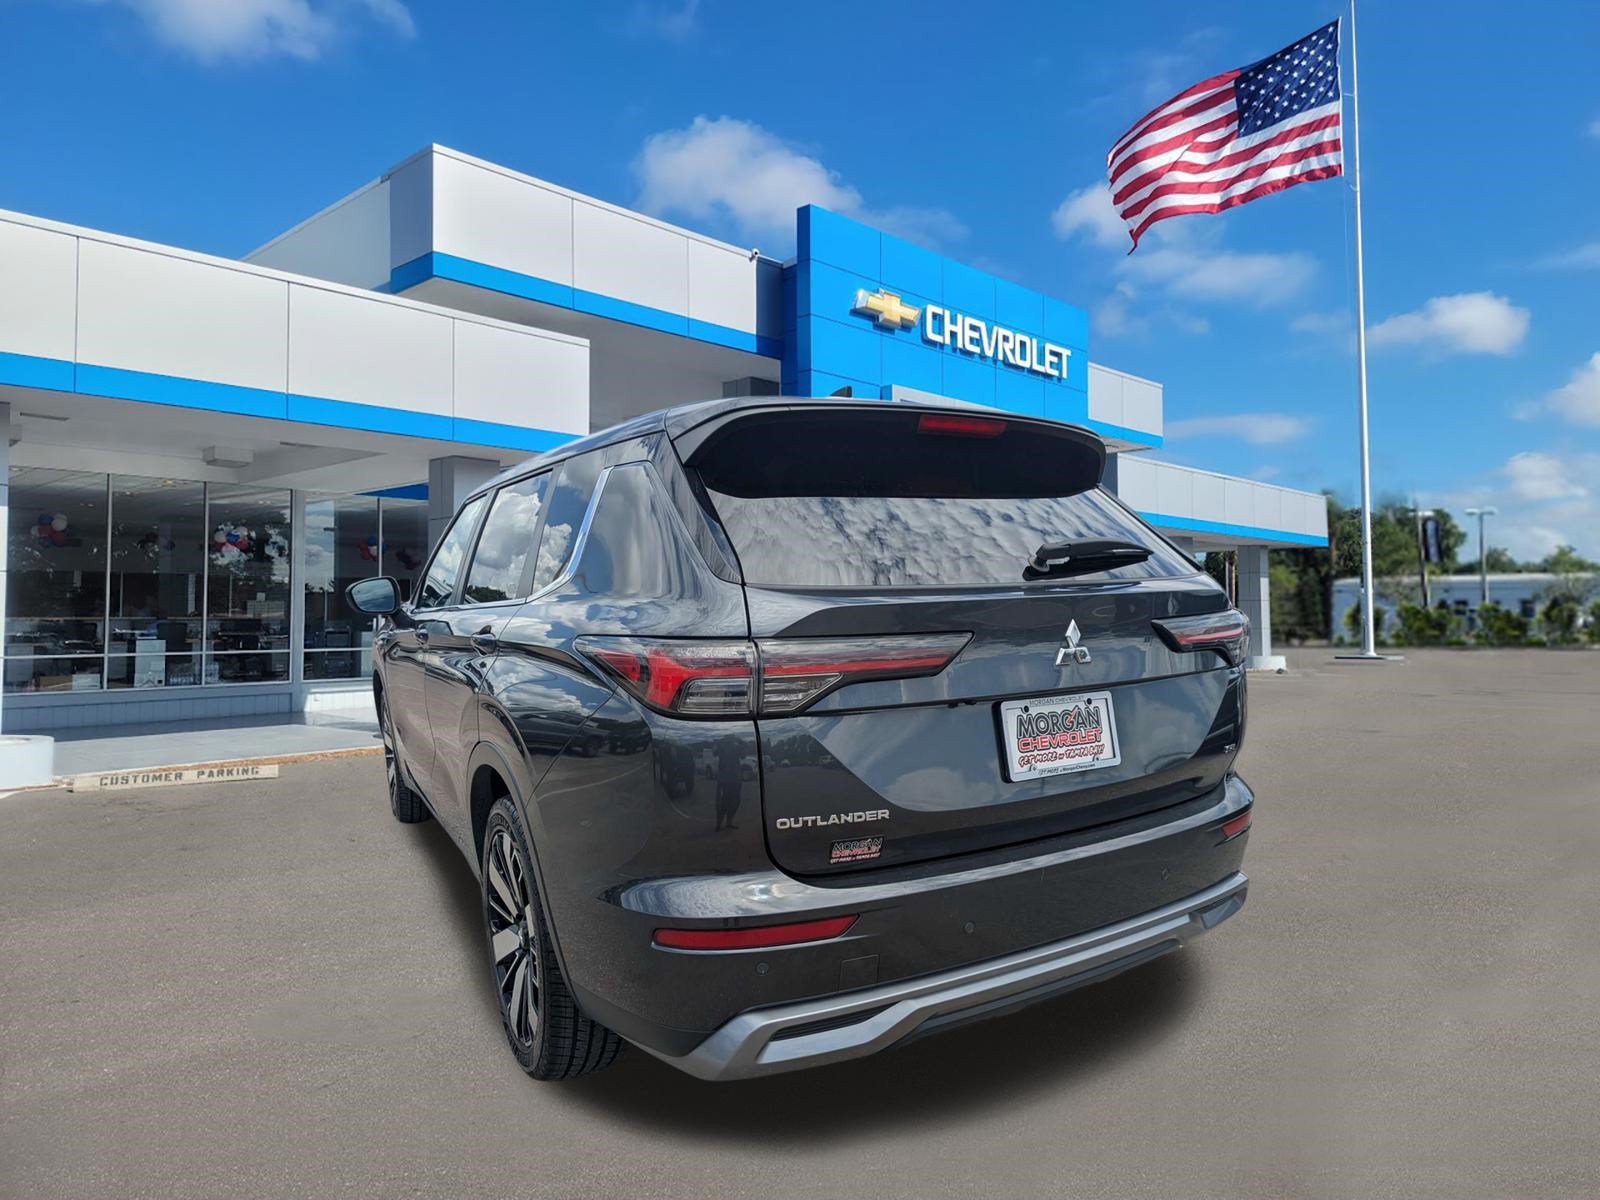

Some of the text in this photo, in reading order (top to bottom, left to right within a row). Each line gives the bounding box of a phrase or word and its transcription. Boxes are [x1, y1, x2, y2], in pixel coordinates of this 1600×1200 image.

[925, 303, 1072, 379] CHEVROLET
[1017, 705, 1102, 738] MORGAN
[1019, 727, 1102, 752] CHEVROLET
[1018, 754, 1035, 768] GET
[1035, 750, 1057, 764] MORE
[1065, 745, 1089, 759] TAMPA
[99, 767, 259, 786] CUSTOMER PARKING
[775, 809, 890, 829] OUTLANDER
[832, 838, 883, 852] MORGAN
